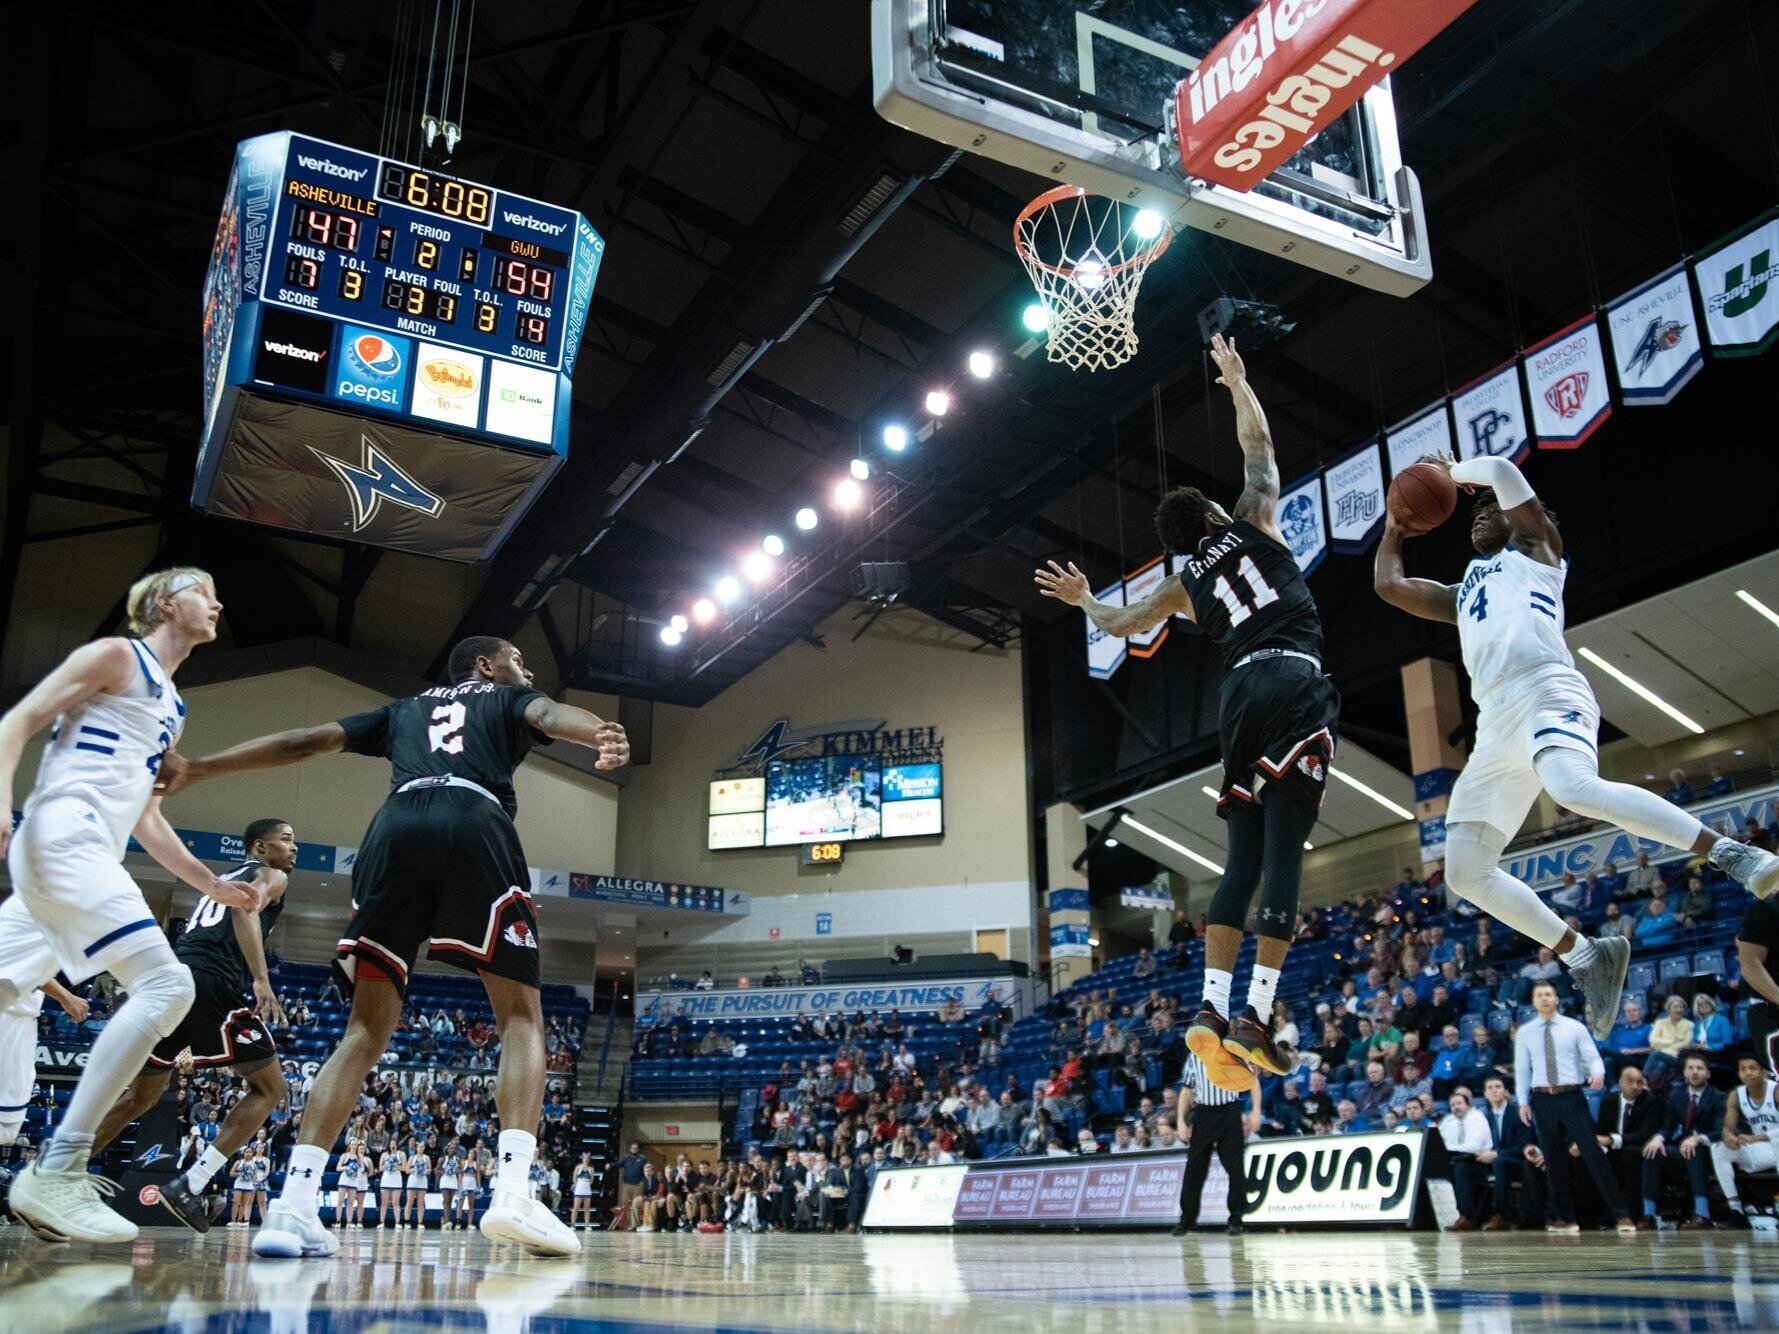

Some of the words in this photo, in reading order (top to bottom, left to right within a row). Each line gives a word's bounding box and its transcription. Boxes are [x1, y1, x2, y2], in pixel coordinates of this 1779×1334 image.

[1213, 34, 1396, 173] ingles
[298, 154, 360, 182] verizon
[288, 180, 377, 217] ASHEVILLE
[408, 172, 488, 222] 6:08
[309, 210, 357, 250] 47
[410, 222, 451, 242] PERIOD
[503, 211, 560, 236] verizon
[510, 240, 540, 259] GWU
[579, 223, 605, 252] UNC
[287, 242, 326, 262] FOULS
[339, 255, 371, 273] T.O.L.
[418, 241, 437, 269] 2
[344, 271, 362, 299] 3
[384, 267, 428, 287] PLAYER
[433, 279, 462, 296] FOUL
[507, 261, 551, 300] 54
[1723, 248, 1771, 318] U
[278, 289, 319, 309] SCORE
[407, 287, 425, 315] 3
[473, 289, 504, 307] T.O.L.
[517, 300, 552, 318] FOULS
[563, 242, 596, 373] ASHEVILLE
[397, 317, 437, 337] MATCH
[478, 305, 496, 332] 3
[528, 318, 544, 342] 4
[264, 340, 319, 363] verizon
[511, 345, 547, 363] SCORE
[1535, 337, 1588, 372] RADFORD
[1537, 348, 1588, 382] UNIVERSITY
[1335, 489, 1380, 529] HPU
[1212, 554, 1280, 629] 11
[1469, 584, 1489, 623] 4
[428, 701, 467, 755] 2
[820, 726, 945, 757] KIMMEL
[220, 847, 246, 856] Raised
[811, 843, 841, 861] 6:08
[1509, 843, 1595, 884] UNC
[596, 877, 665, 894] ALLEGRA
[679, 997, 719, 1015] THE
[721, 993, 806, 1013] PURSUIT
[810, 992, 841, 1009] OF
[842, 985, 966, 1008] GREATNESS
[1011, 1177, 1035, 1189] FARM
[1053, 1174, 1079, 1187] FARM
[1100, 1170, 1127, 1184] FARM
[1150, 1167, 1179, 1182] FARM
[1240, 1143, 1413, 1216] young
[1041, 1186, 1077, 1200] BUREAU
[1086, 1183, 1124, 1198] BUREAU
[1136, 1181, 1177, 1197] BUREAU
